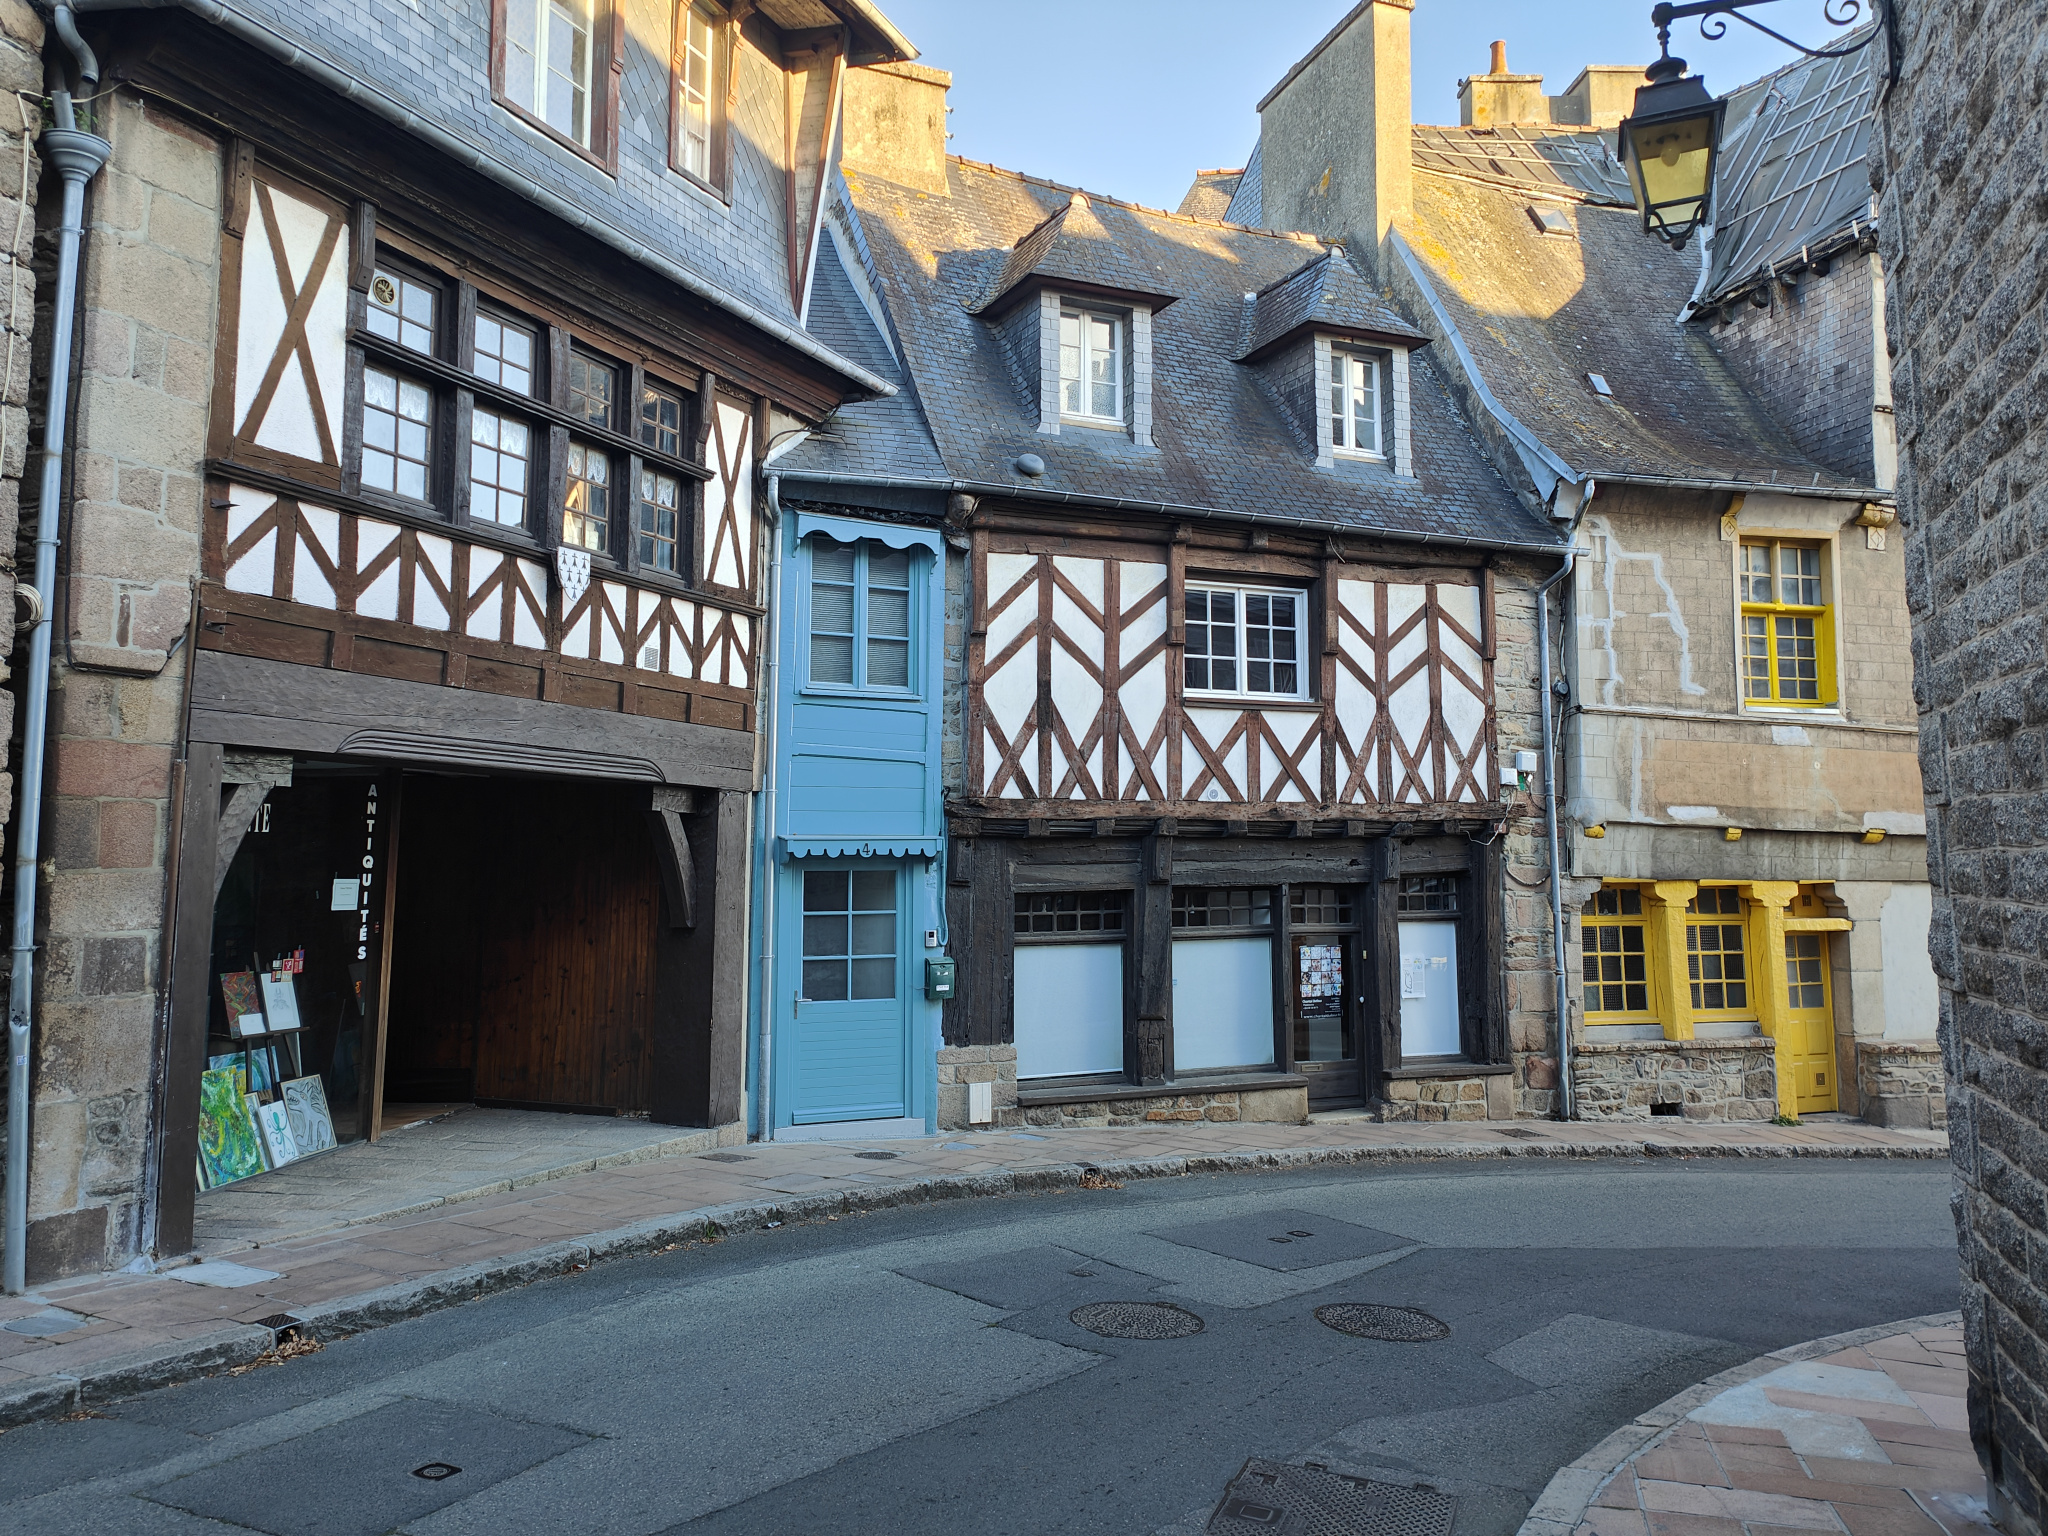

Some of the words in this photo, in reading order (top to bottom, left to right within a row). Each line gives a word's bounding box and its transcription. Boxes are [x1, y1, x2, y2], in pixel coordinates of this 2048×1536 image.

[248, 803, 271, 832] TE
[862, 842, 871, 856] 4
[357, 784, 378, 960] ANTIQUITÉS
